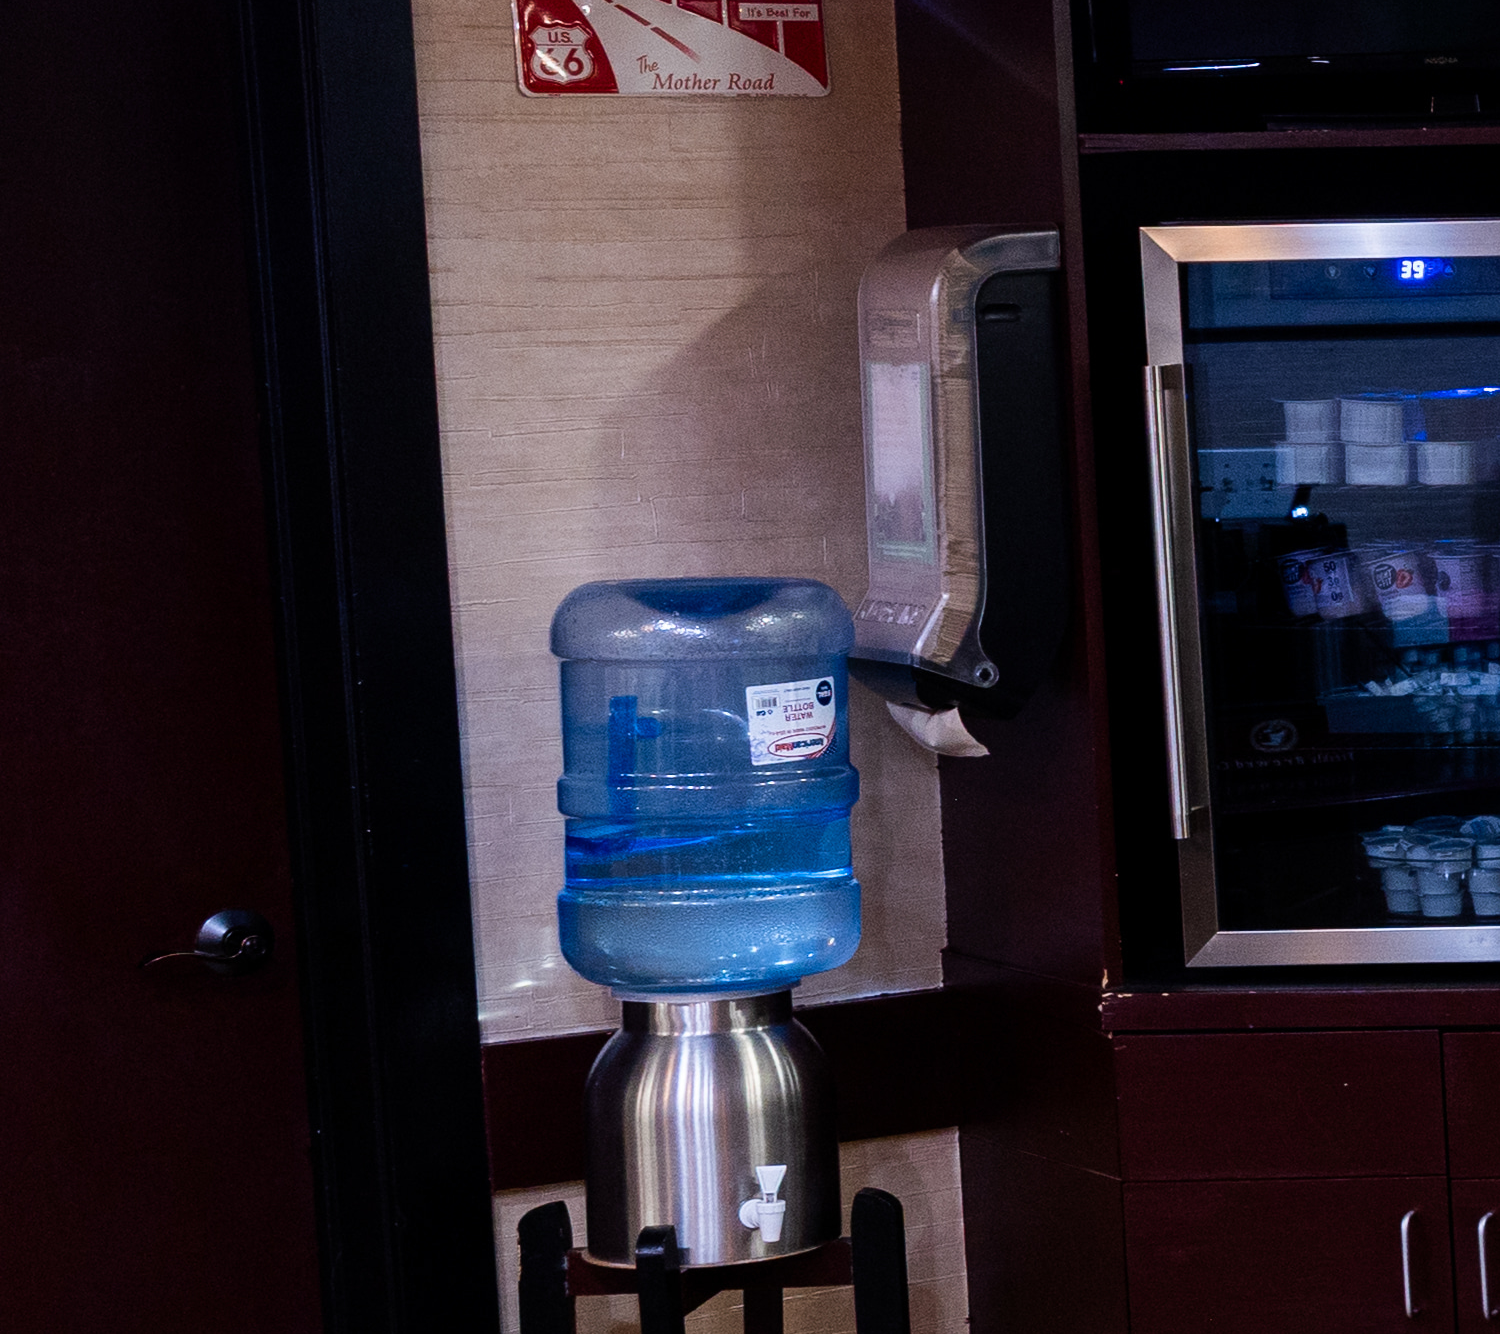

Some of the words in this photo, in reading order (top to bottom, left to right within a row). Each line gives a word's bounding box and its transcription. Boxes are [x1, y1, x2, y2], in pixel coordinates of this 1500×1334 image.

[766, 7, 790, 18] Best
[793, 8, 812, 19] For
[635, 54, 660, 75] The
[652, 72, 721, 91] Mother
[727, 72, 775, 91] Road
[1400, 259, 1425, 279] 39
[782, 701, 815, 714] BOTTLE
[785, 711, 814, 722] WATER
